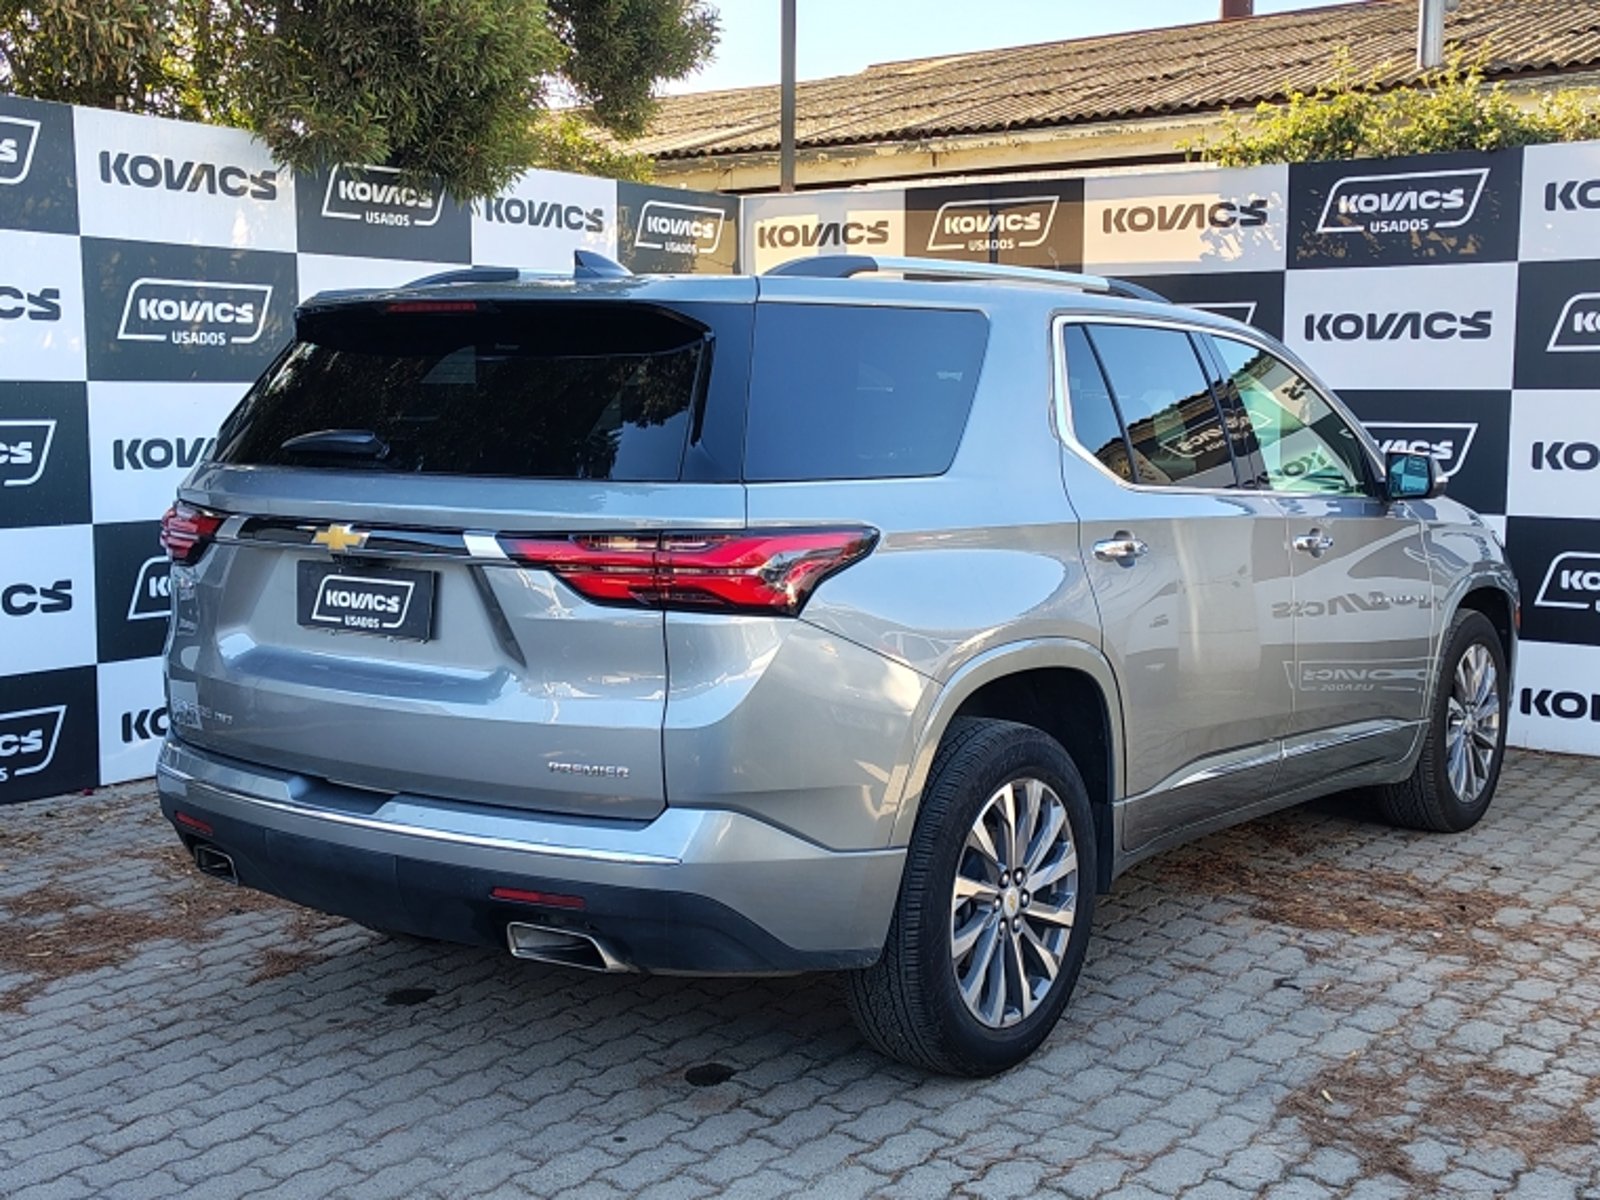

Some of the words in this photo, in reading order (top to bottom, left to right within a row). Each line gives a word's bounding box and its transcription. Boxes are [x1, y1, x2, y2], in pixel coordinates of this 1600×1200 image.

[99, 150, 278, 201] KOVACS
[338, 180, 433, 209] KOVACS
[1338, 188, 1464, 215] KOVACS
[365, 210, 411, 227] USADOS
[484, 197, 604, 233] KOVACS
[944, 211, 1041, 236] KOVACS
[1102, 198, 1269, 234] KOVACS
[1369, 218, 1430, 234] USADOS
[646, 216, 715, 239] KOVACS
[757, 219, 889, 250] KOVACS
[664, 241, 698, 254] USADOS
[968, 237, 1015, 252] USADOS
[138, 298, 254, 324] KOVACS
[171, 330, 227, 346] USADOS
[1304, 310, 1493, 342] KOVACS
[325, 589, 400, 613] KOVACS
[344, 615, 380, 628] USADOS
[547, 761, 630, 778] PREMIER
